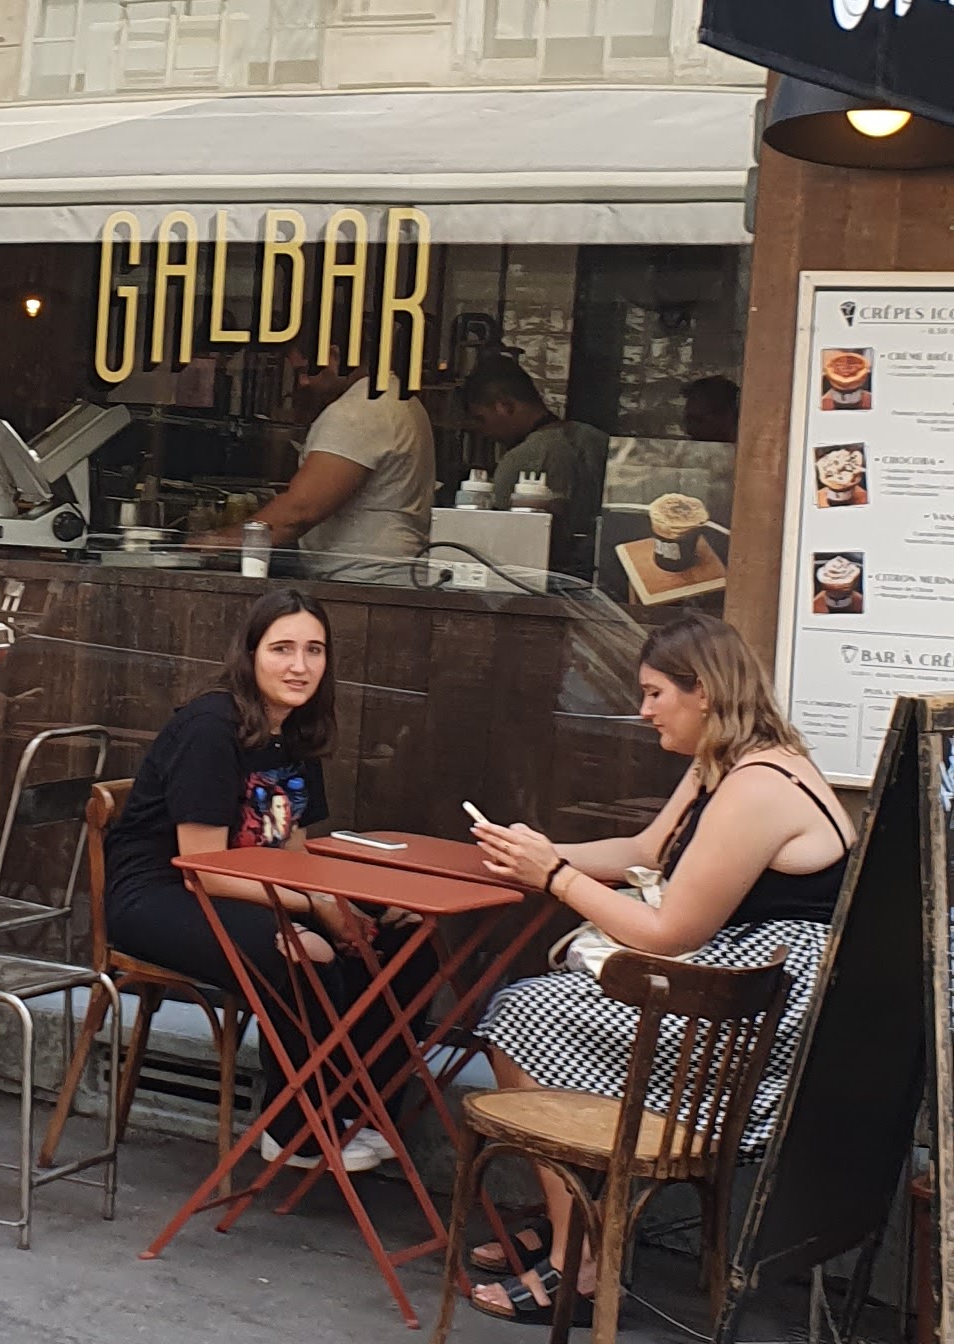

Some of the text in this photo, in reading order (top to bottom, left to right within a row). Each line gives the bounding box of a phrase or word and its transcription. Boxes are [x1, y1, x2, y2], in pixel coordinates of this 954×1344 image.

[94, 206, 432, 393] GALBAR
[859, 304, 925, 319] CRÊPES
[861, 649, 895, 664] BAR
[919, 652, 954, 668] CRÊ
